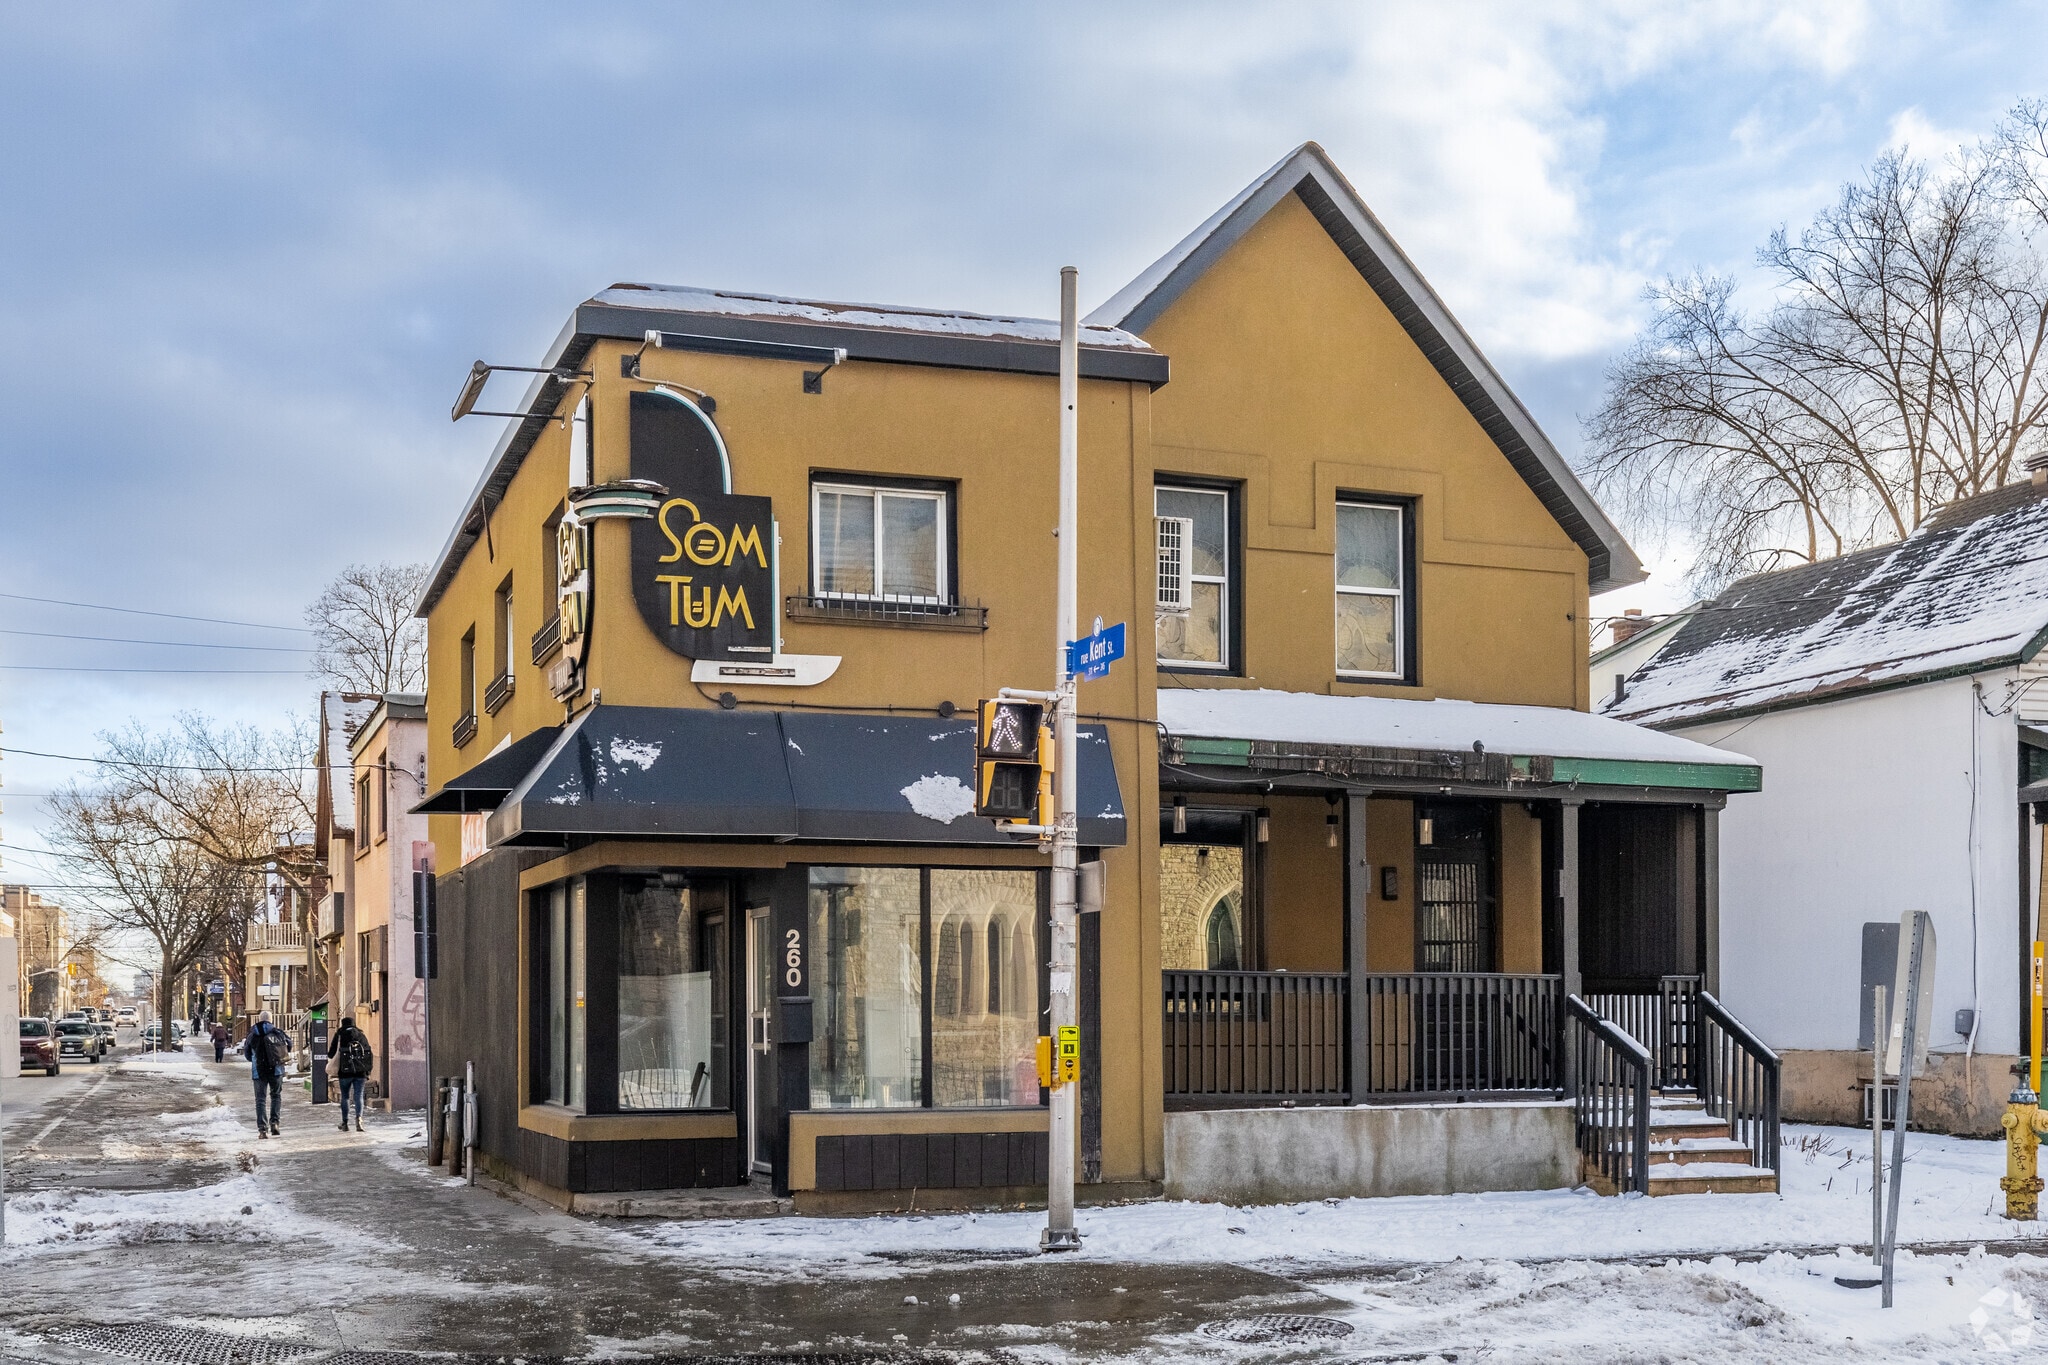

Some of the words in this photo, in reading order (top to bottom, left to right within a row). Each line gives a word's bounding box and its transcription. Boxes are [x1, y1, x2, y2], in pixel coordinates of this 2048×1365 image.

[658, 498, 768, 568] SOM
[655, 575, 755, 629] TUM
[1081, 653, 1089, 665] rue
[1090, 637, 1106, 661] Kent
[786, 929, 801, 987] 260
